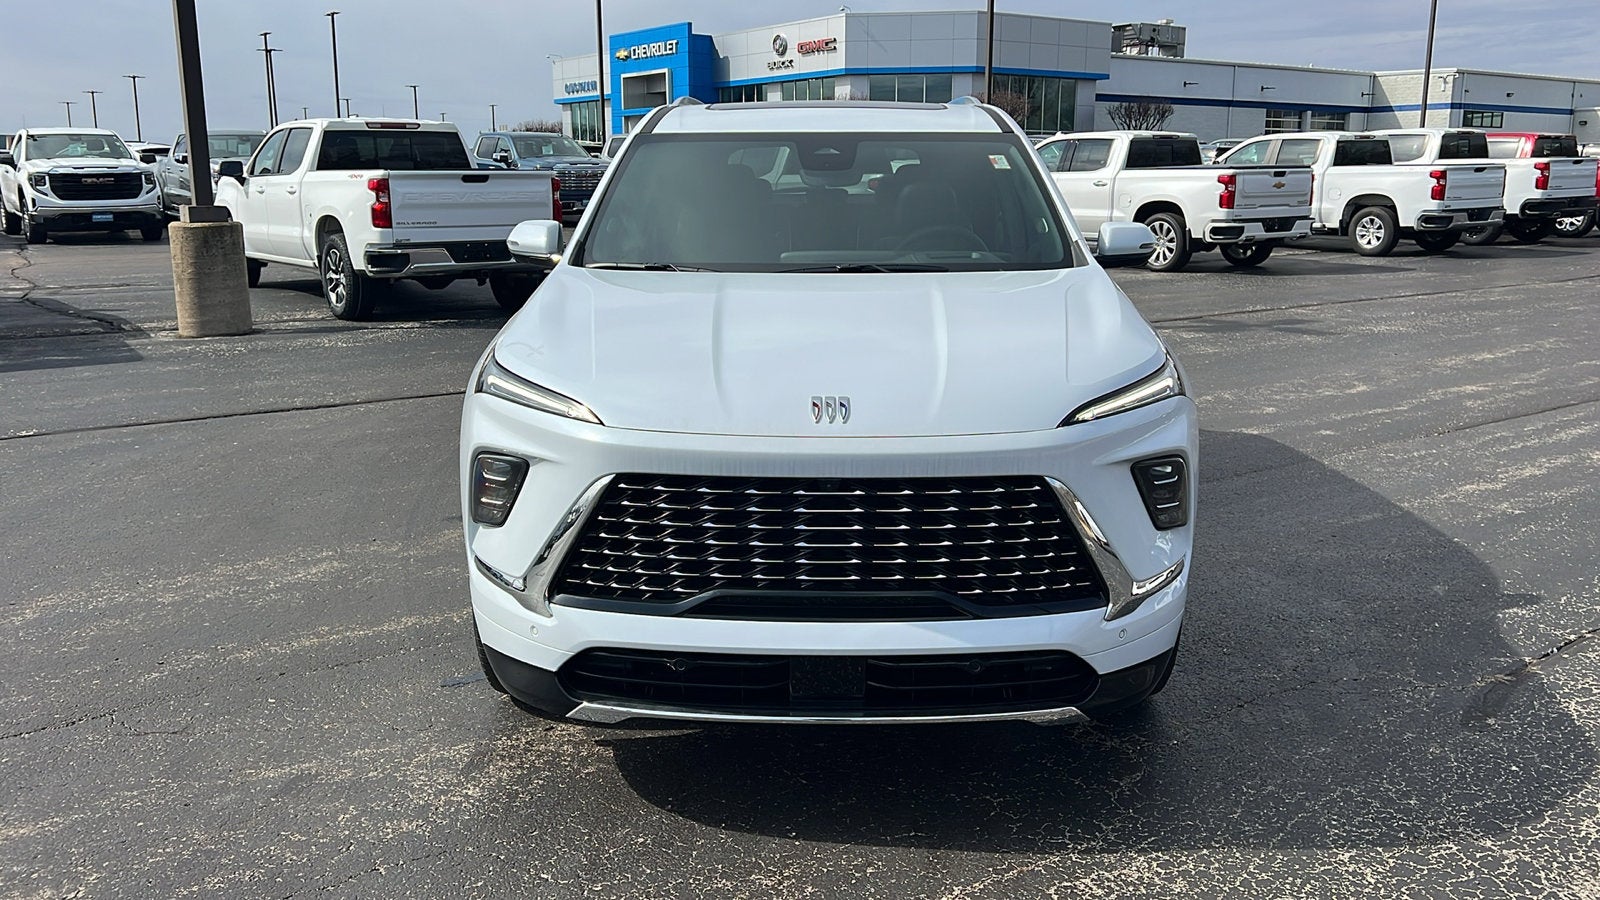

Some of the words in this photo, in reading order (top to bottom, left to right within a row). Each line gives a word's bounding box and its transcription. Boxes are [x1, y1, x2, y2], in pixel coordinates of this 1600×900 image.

[630, 39, 678, 60] CHEVROLET
[797, 37, 837, 54] GMC
[767, 59, 794, 71] BUICK
[81, 177, 115, 185] GMC
